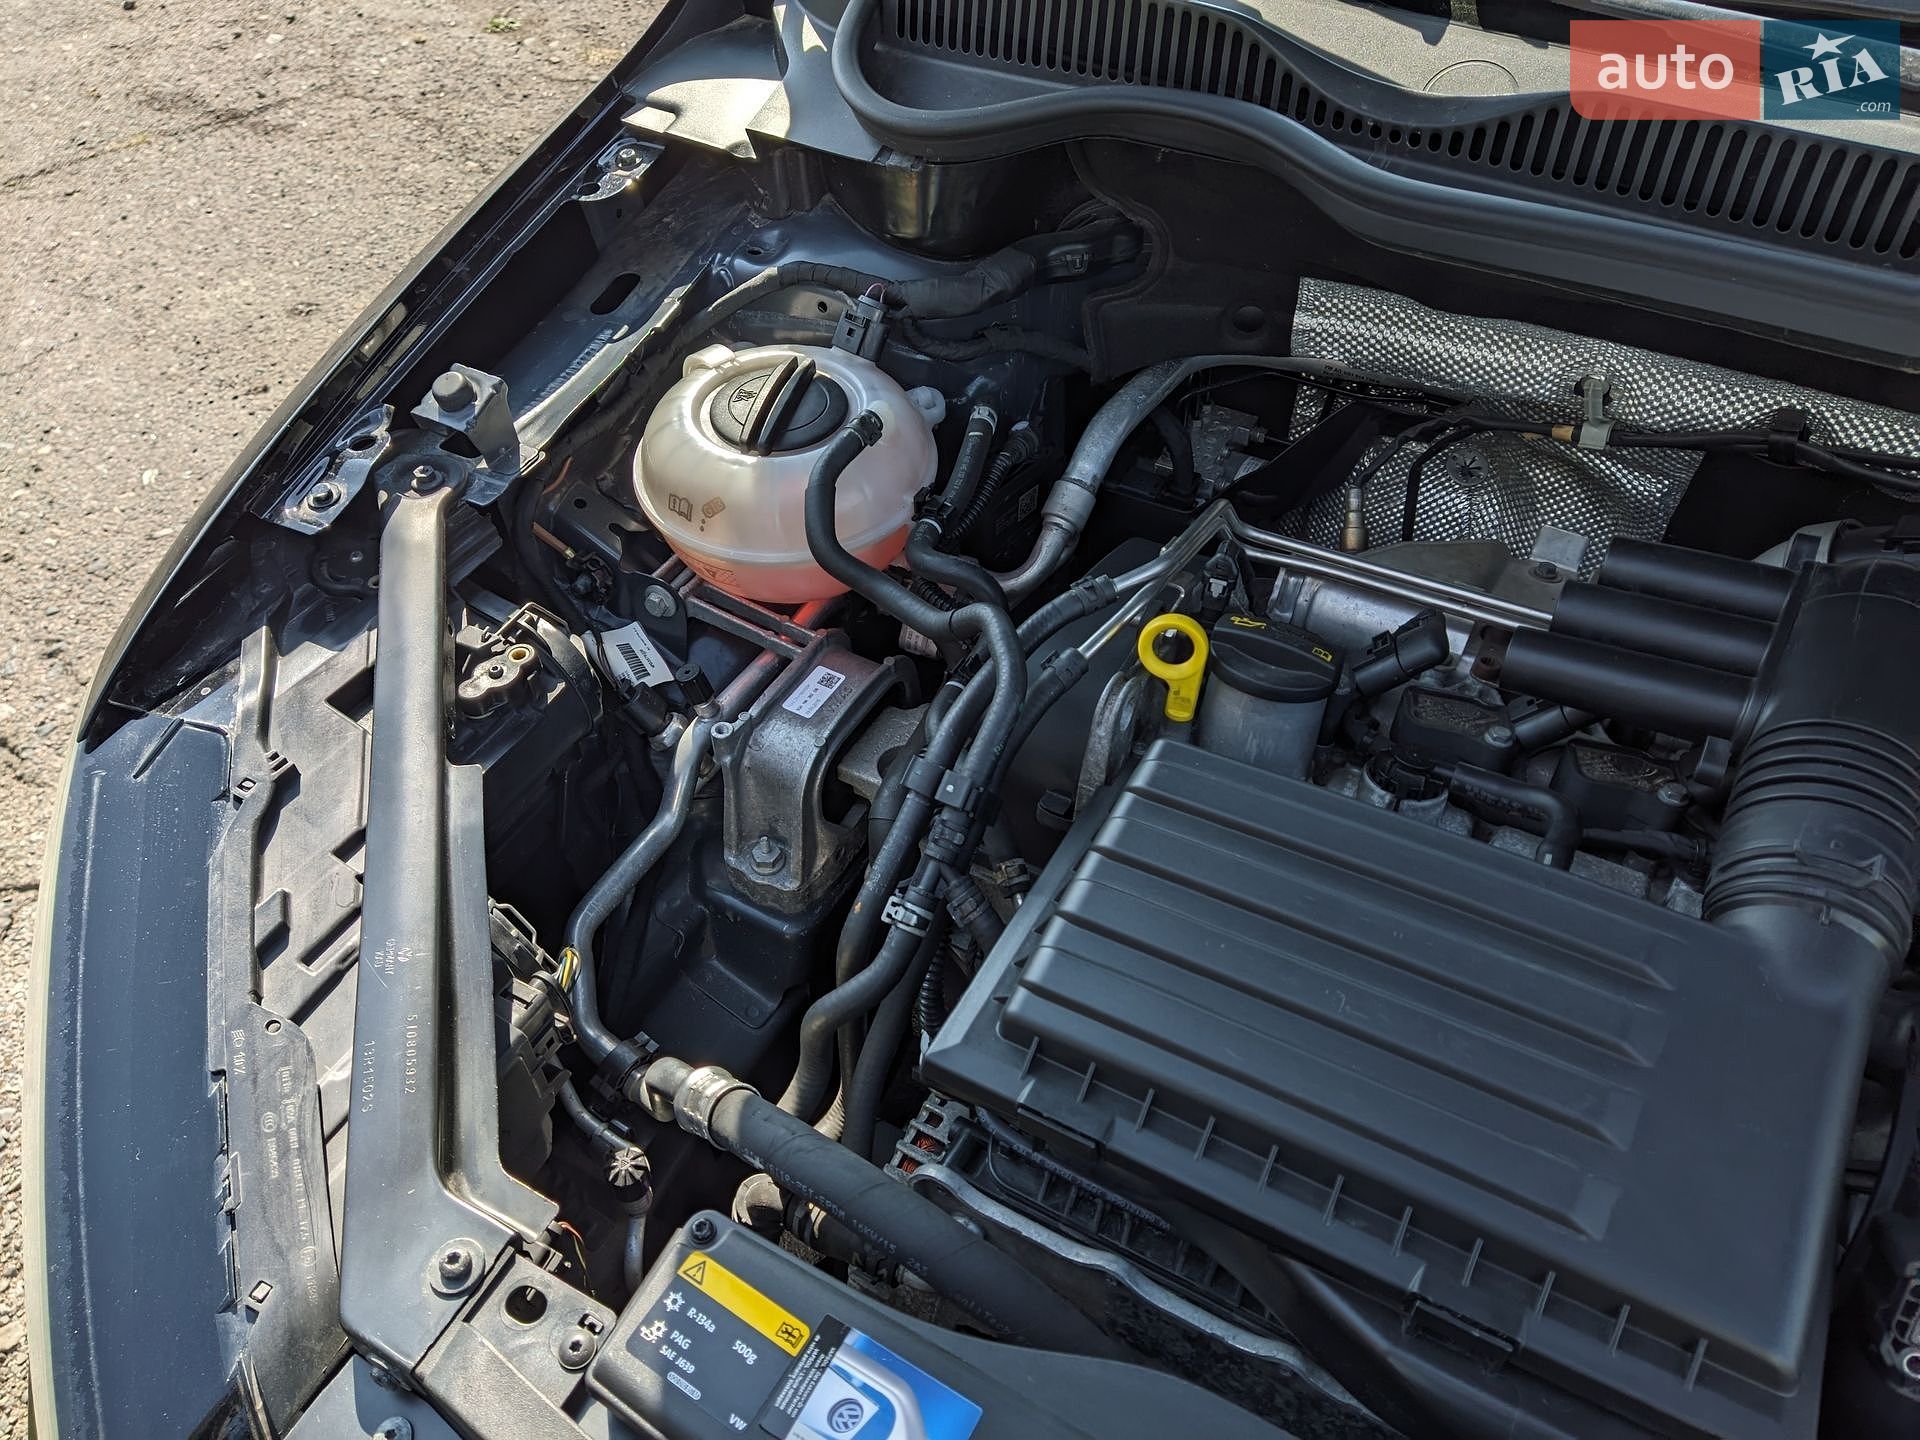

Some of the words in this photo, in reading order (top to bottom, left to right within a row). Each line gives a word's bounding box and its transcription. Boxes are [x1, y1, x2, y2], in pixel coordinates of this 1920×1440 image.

[687, 1307, 716, 1333] R-134a
[669, 1330, 692, 1350] PAG
[732, 1340, 758, 1365] 500g
[660, 1345, 677, 1361] SAE
[675, 1356, 695, 1374] J639
[729, 1413, 747, 1431] VW
